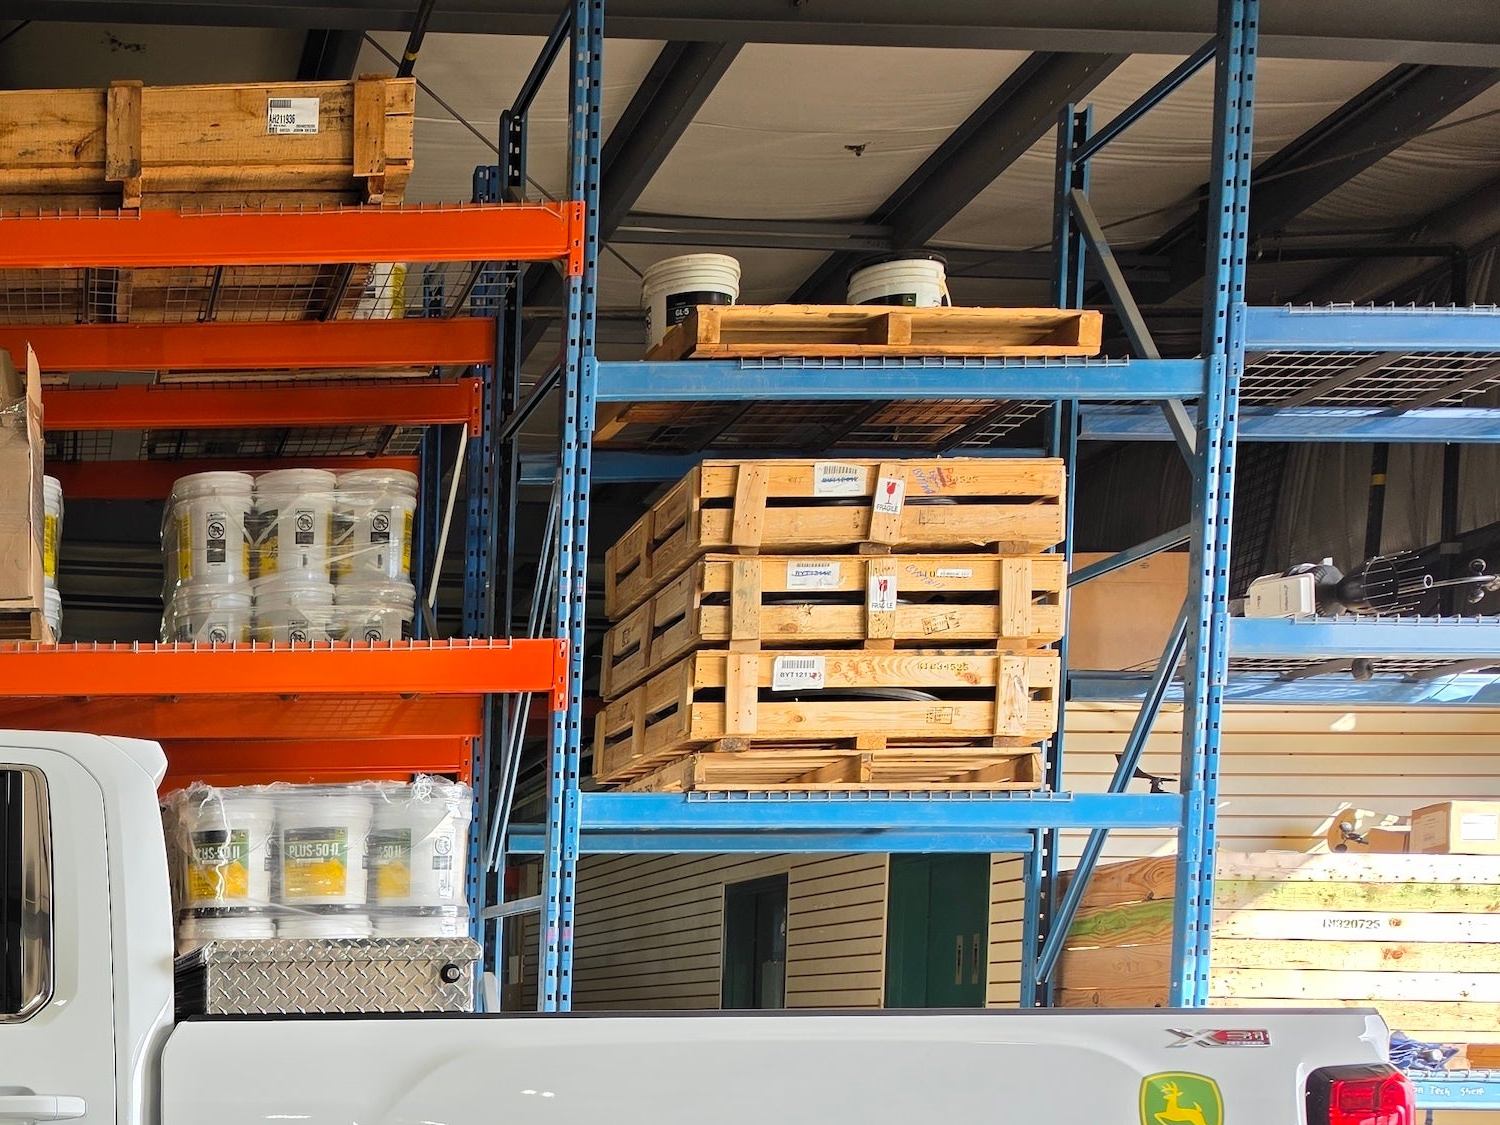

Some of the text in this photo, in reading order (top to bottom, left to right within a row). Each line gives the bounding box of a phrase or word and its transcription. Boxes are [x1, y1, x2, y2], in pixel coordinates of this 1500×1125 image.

[269, 114, 296, 124] AH211936
[876, 503, 899, 513] FRAGILE
[289, 843, 328, 858] PLUS-50
[1430, 1085, 1451, 1096] Tech
